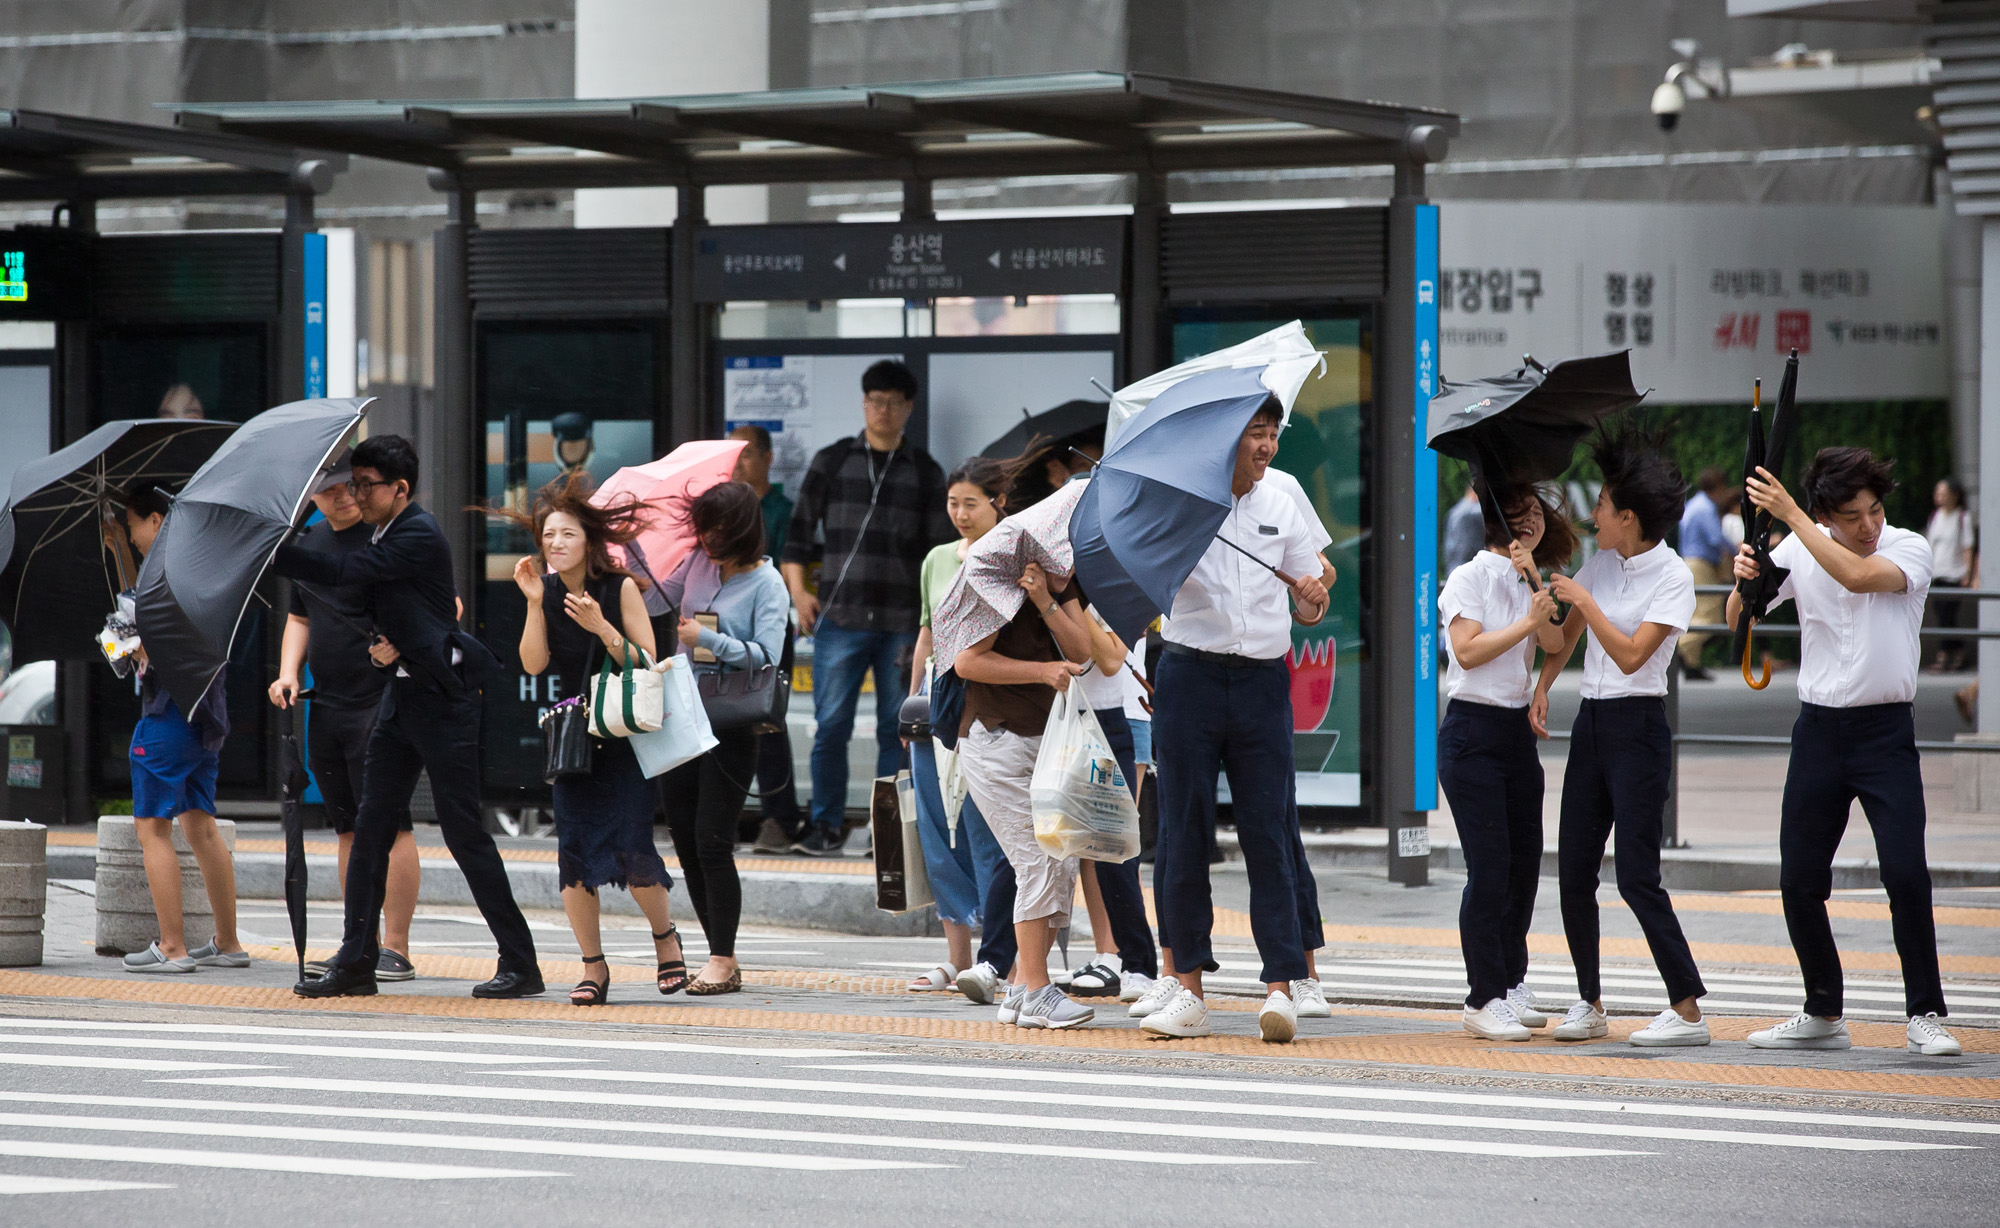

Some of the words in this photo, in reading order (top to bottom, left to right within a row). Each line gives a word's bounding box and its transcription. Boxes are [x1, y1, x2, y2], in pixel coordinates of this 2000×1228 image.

[889, 233, 944, 263] 용산역
[1441, 327, 1508, 346] ntrance
[1418, 571, 1431, 627] Yongsan
[1420, 633, 1432, 680] Station
